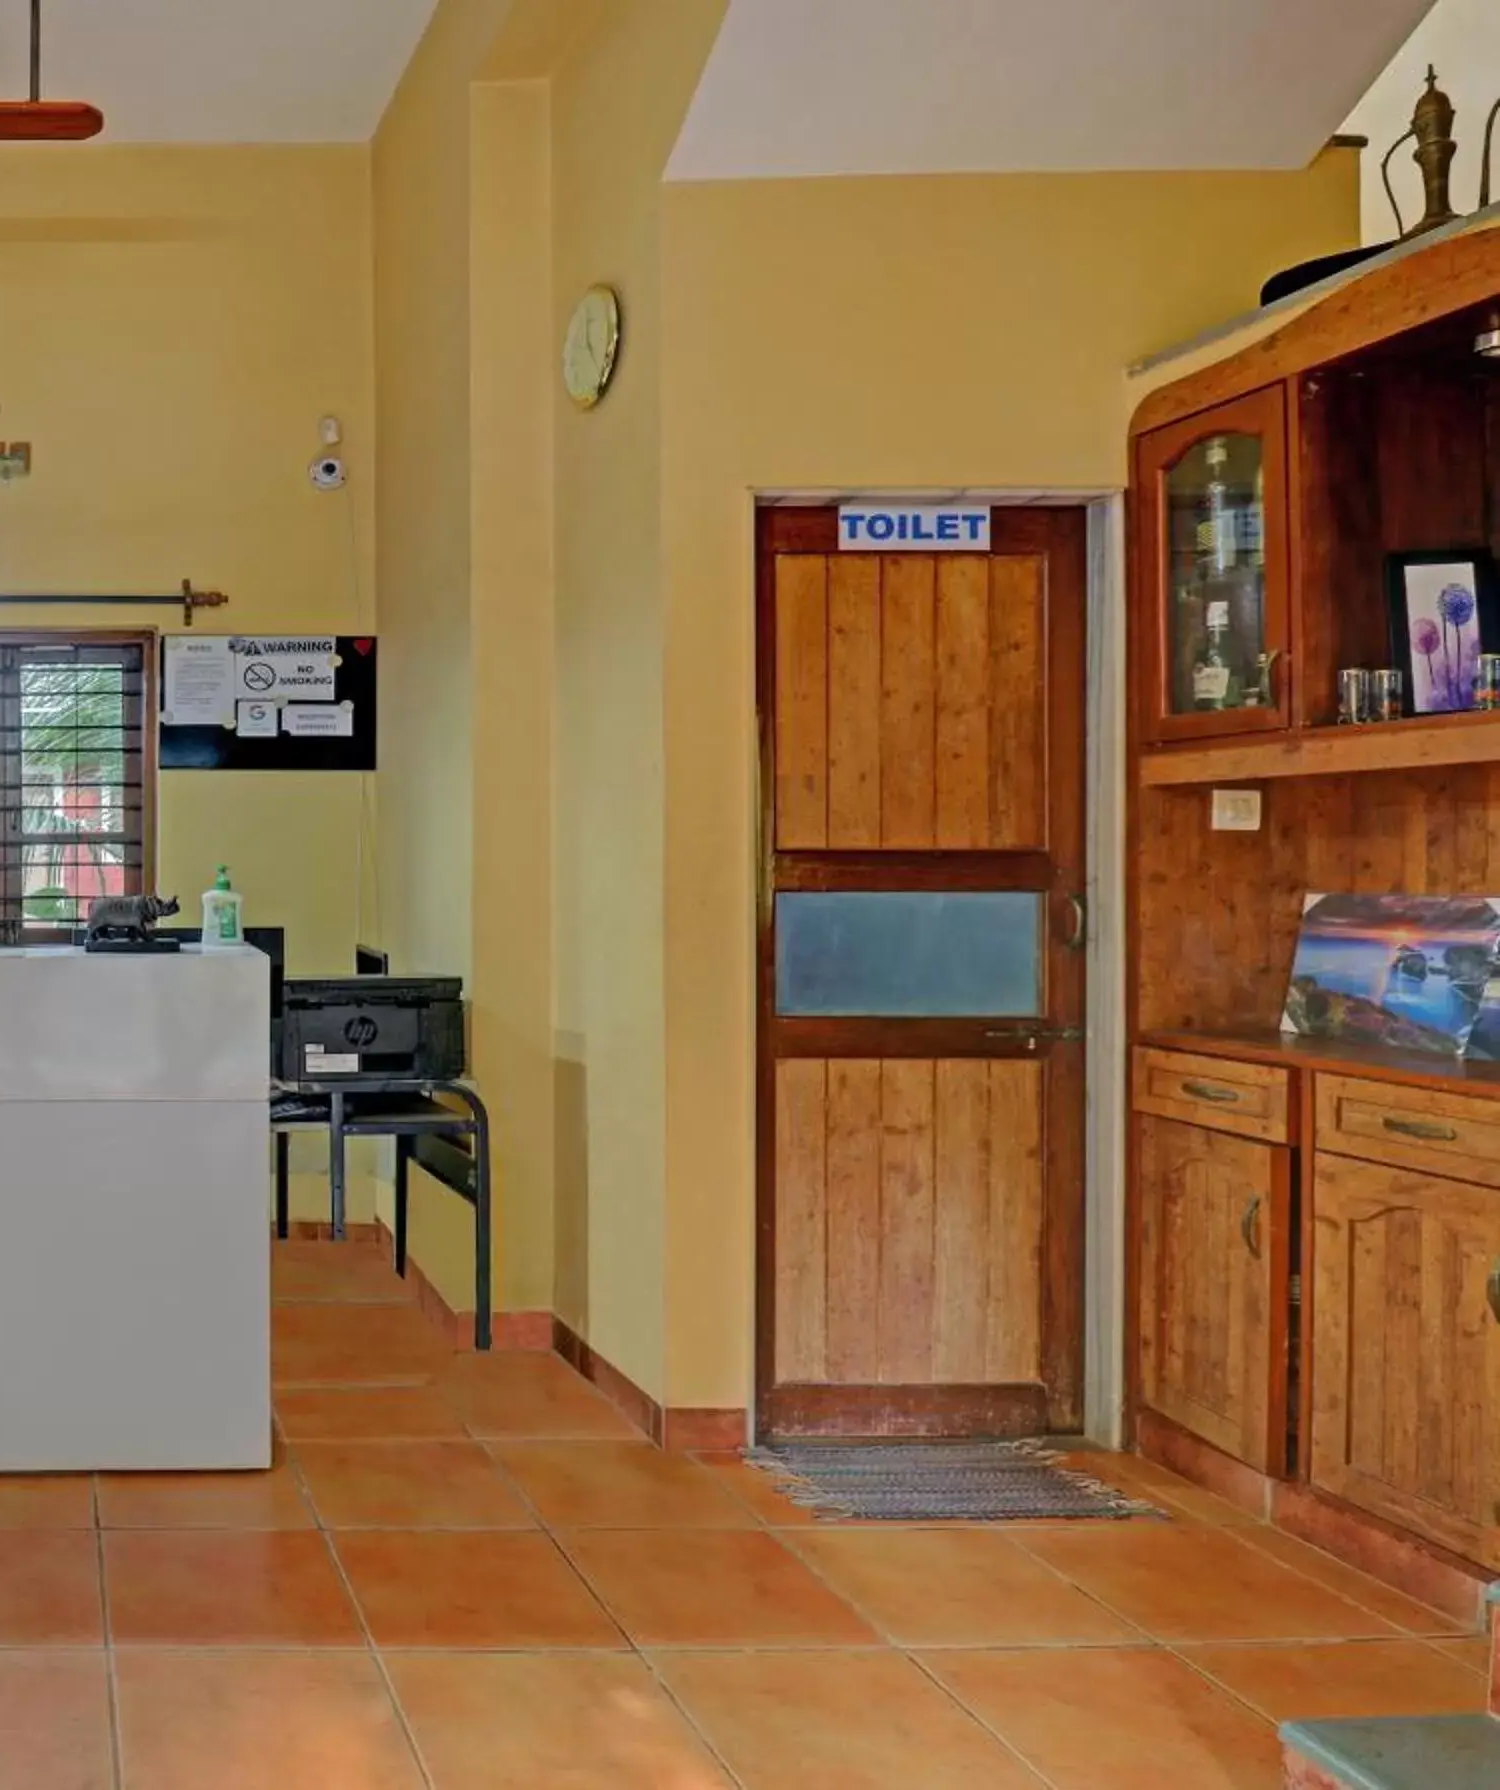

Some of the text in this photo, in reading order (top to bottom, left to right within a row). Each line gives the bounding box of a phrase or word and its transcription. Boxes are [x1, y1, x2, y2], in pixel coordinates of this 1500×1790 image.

[840, 513, 987, 541] TOILET
[263, 641, 333, 653] WARNING
[297, 665, 314, 674] NO
[278, 676, 333, 686] SMOKING
[348, 1016, 377, 1048] hp
